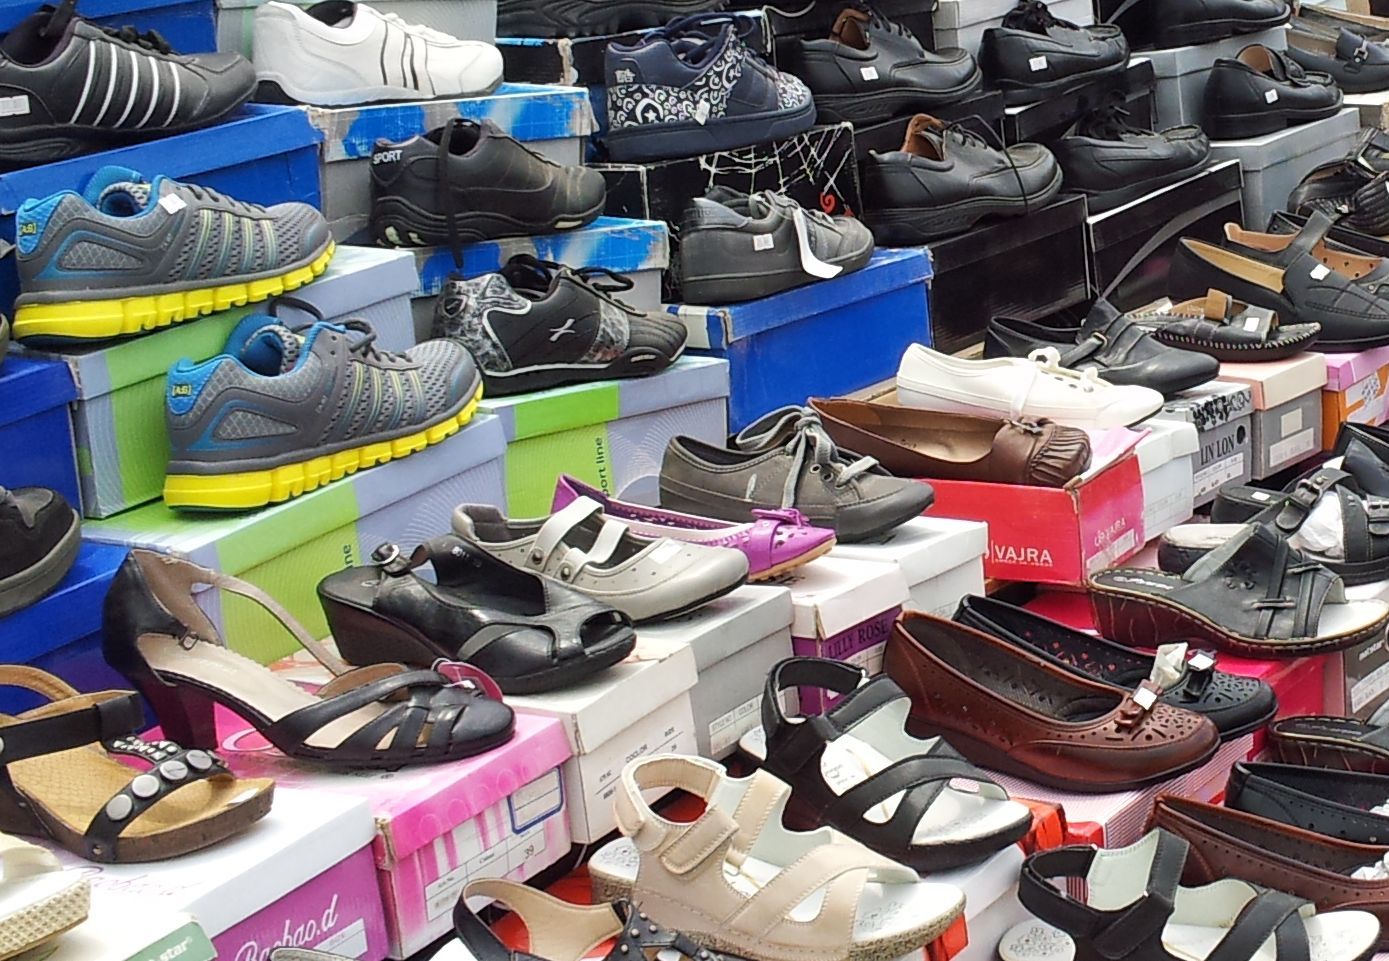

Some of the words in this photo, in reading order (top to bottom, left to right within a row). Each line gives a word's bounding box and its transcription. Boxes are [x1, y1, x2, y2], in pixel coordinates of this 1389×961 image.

[373, 149, 403, 165] SPORT
[595, 437, 605, 464] line
[994, 544, 1053, 564] VAJRA
[857, 620, 888, 644] ROSE
